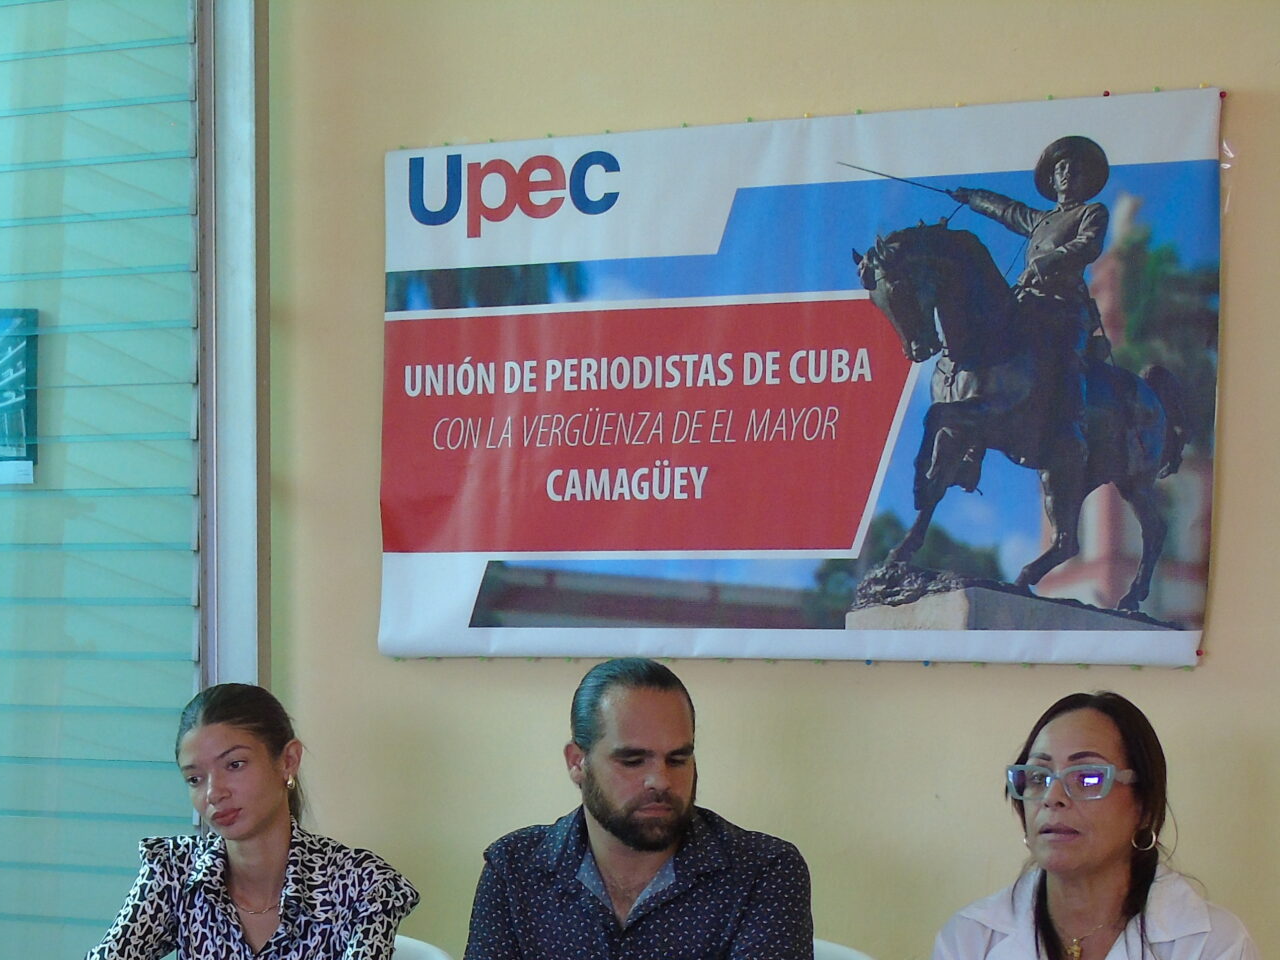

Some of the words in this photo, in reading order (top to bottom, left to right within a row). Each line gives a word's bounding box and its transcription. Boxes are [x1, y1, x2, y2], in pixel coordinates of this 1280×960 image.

[408, 150, 621, 239] Upec
[404, 356, 495, 397] UNIÓN
[504, 360, 537, 394] DE
[545, 352, 734, 392] PERIODISTAS
[743, 351, 781, 386] DE
[789, 348, 872, 384] CUBA
[433, 416, 482, 450] CON
[485, 415, 512, 448] LA
[523, 407, 663, 447] VERGÜENZA
[672, 410, 706, 444] DE
[709, 409, 736, 443] EL
[744, 406, 840, 442] MAYOR
[546, 459, 709, 502] CAMAGÜEY
